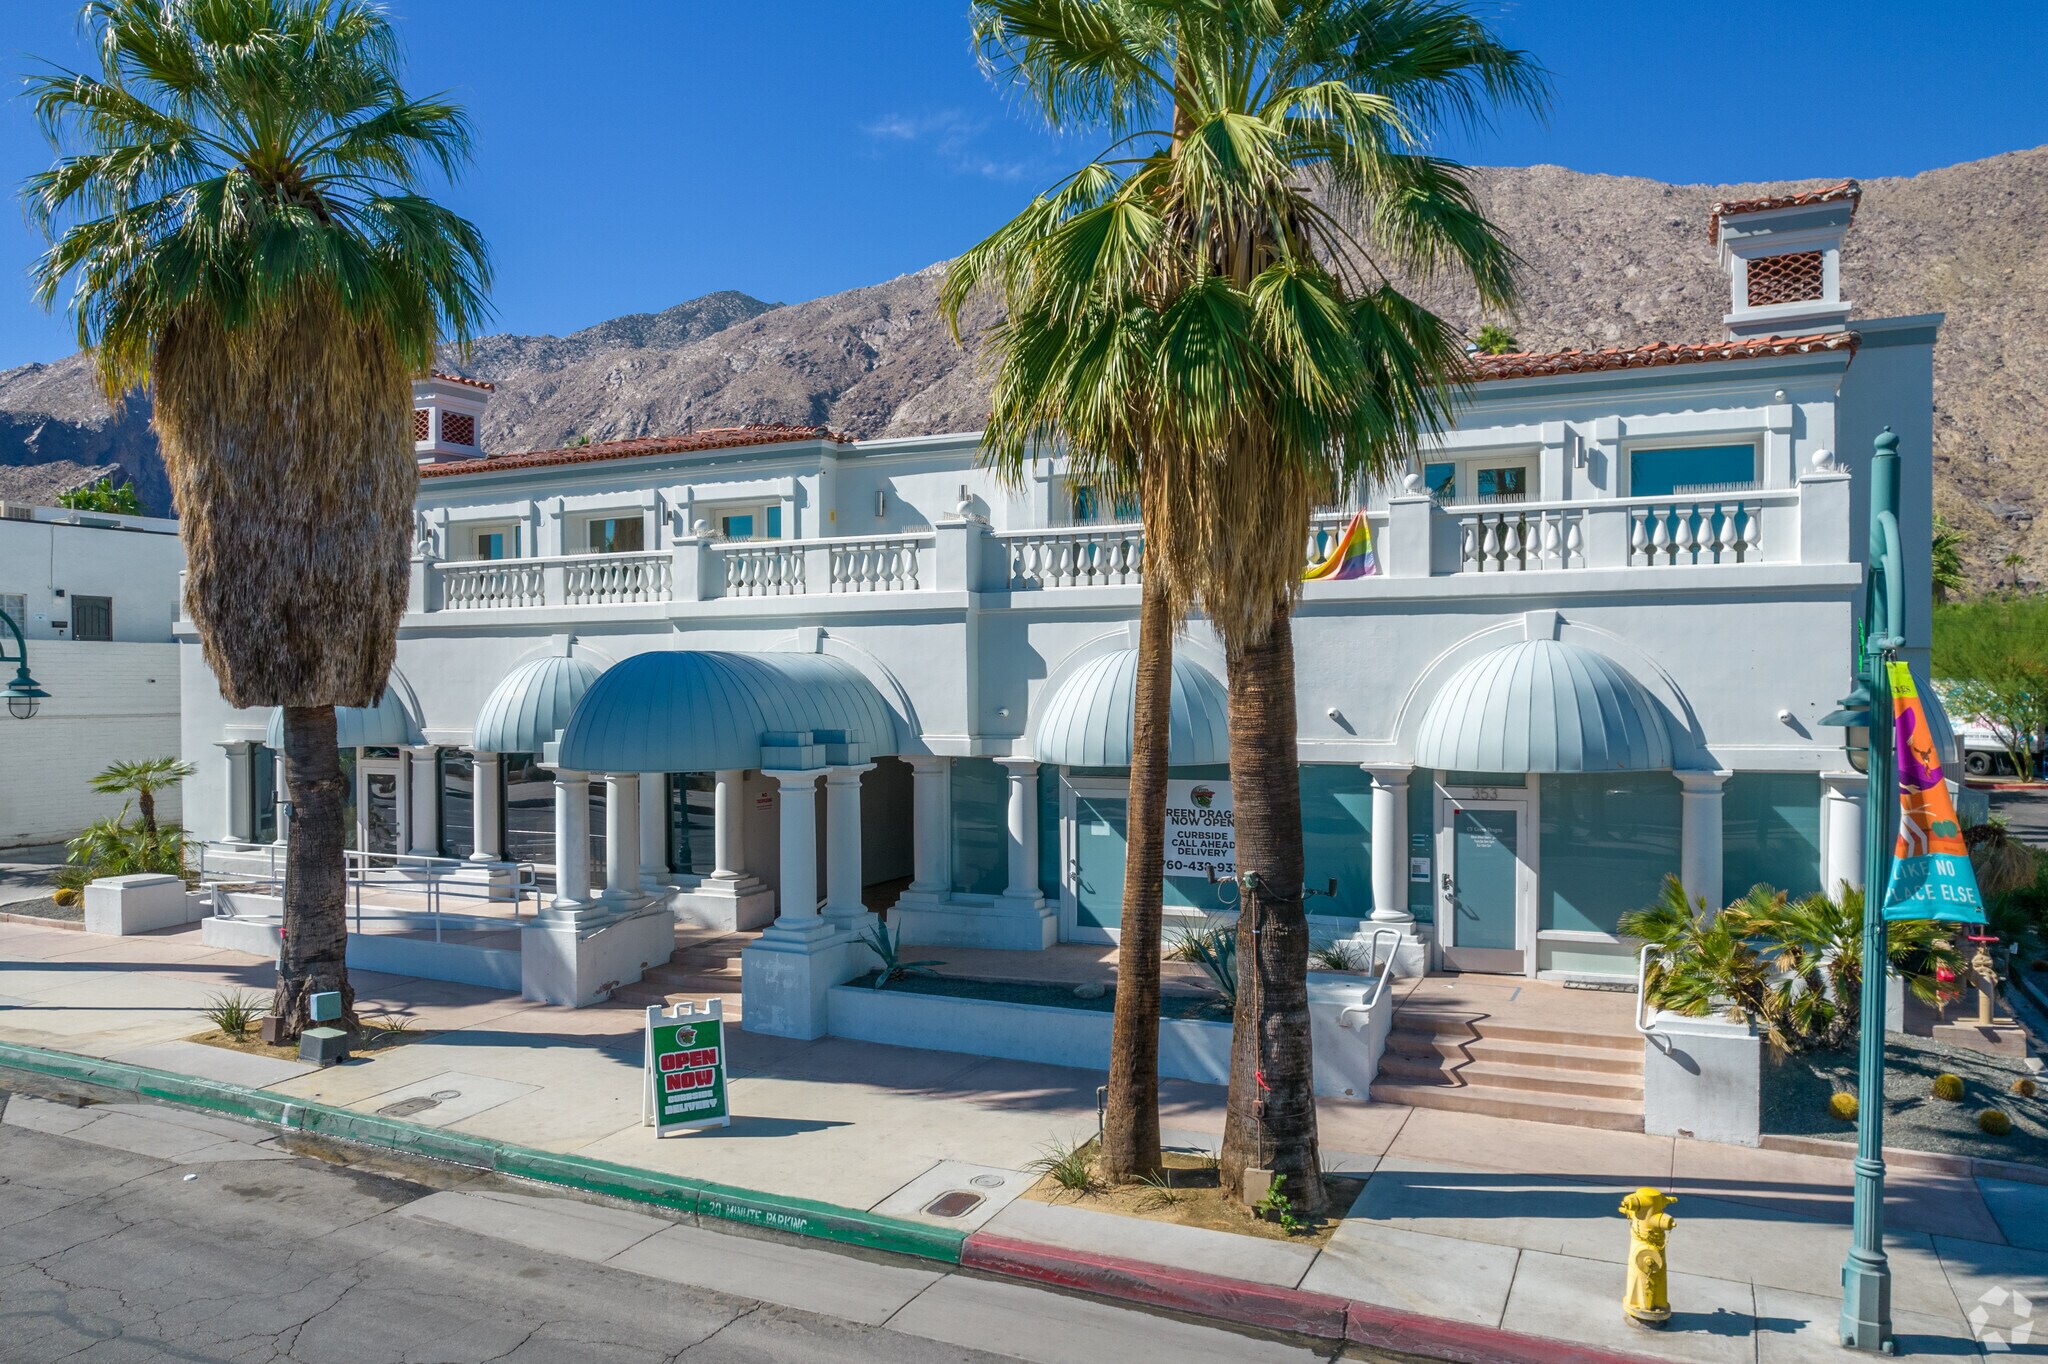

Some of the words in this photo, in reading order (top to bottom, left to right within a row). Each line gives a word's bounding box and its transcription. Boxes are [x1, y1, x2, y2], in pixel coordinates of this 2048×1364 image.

[1472, 787, 1498, 800] 353
[1166, 808, 1196, 817] REEN
[1199, 810, 1235, 819] DRAG
[1171, 817, 1200, 826] NOW
[1203, 818, 1235, 827] OPEN
[1177, 831, 1228, 840] CURBSIDE
[1171, 839, 1198, 848] CALL
[1200, 840, 1236, 849] AHEAD
[1177, 847, 1228, 857] DELIVERY
[1893, 861, 1931, 880] LIKE
[1935, 859, 1956, 877] NO
[1940, 883, 1977, 904] ELSE
[660, 1047, 718, 1072] OPEN
[665, 1068, 715, 1092] NOW
[725, 1204, 762, 1218] MINUTE
[766, 1212, 808, 1229] PARKING
